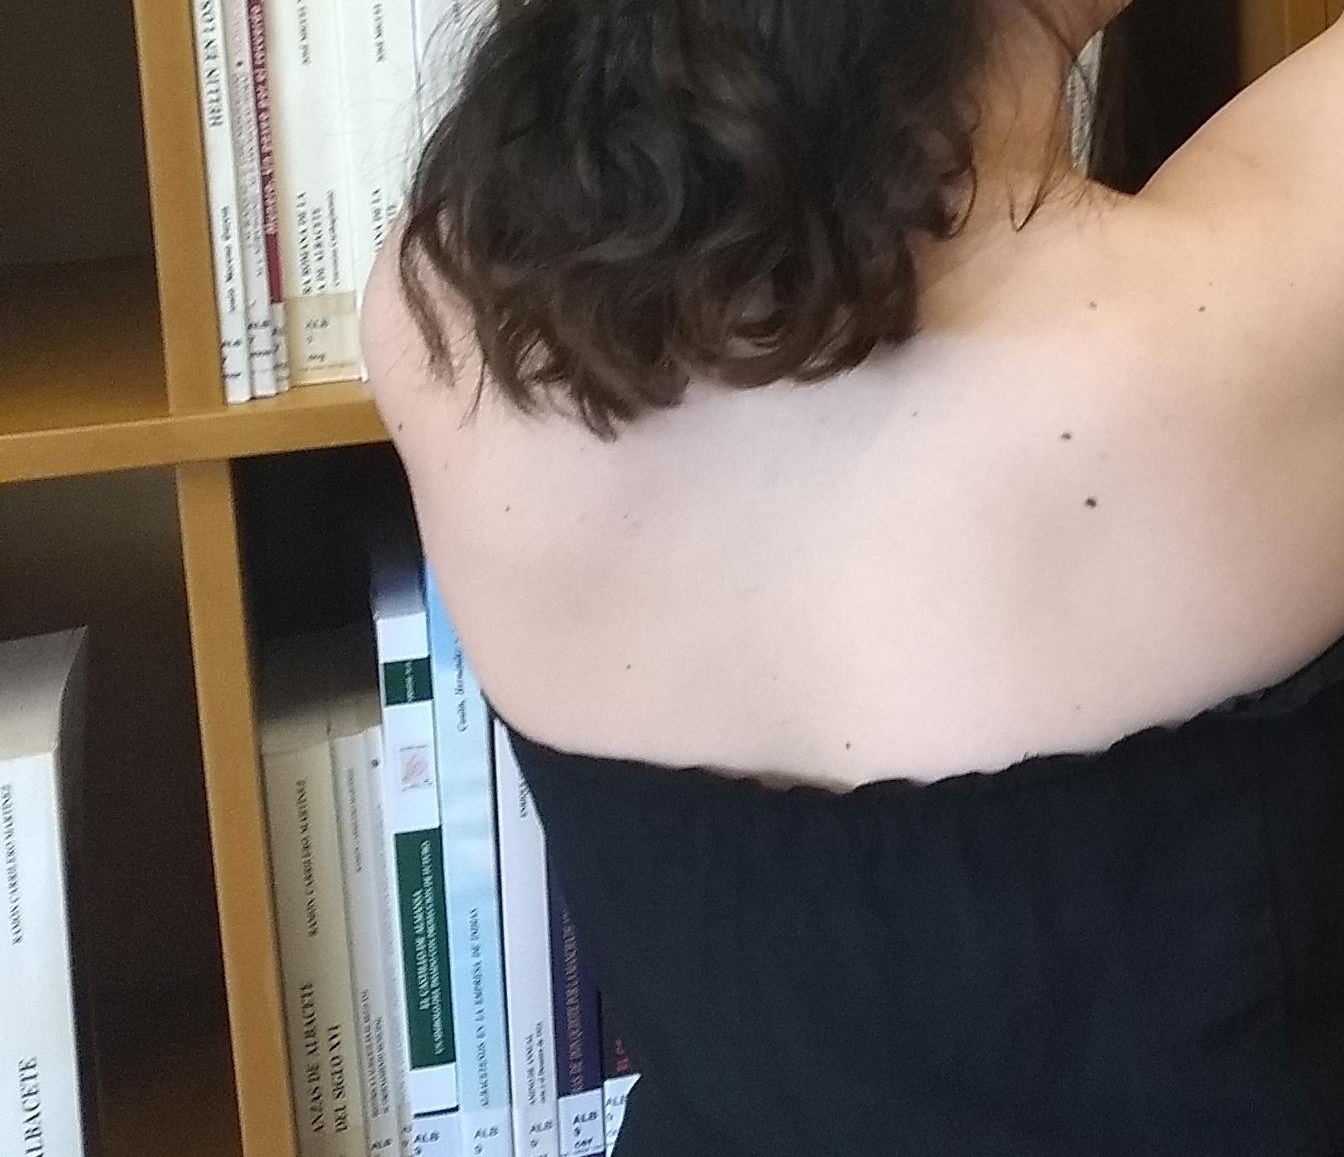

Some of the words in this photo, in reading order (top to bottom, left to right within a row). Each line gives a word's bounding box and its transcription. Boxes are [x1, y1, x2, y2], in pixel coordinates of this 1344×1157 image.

[200, 0, 216, 32] LOS
[203, 38, 218, 60] EN
[300, 982, 319, 1055] ALBACETE
[306, 1063, 321, 1083] DE
[329, 1055, 345, 1100] SIGLO
[18, 1058, 43, 1157] LBACETE
[332, 1105, 348, 1132] DEL
